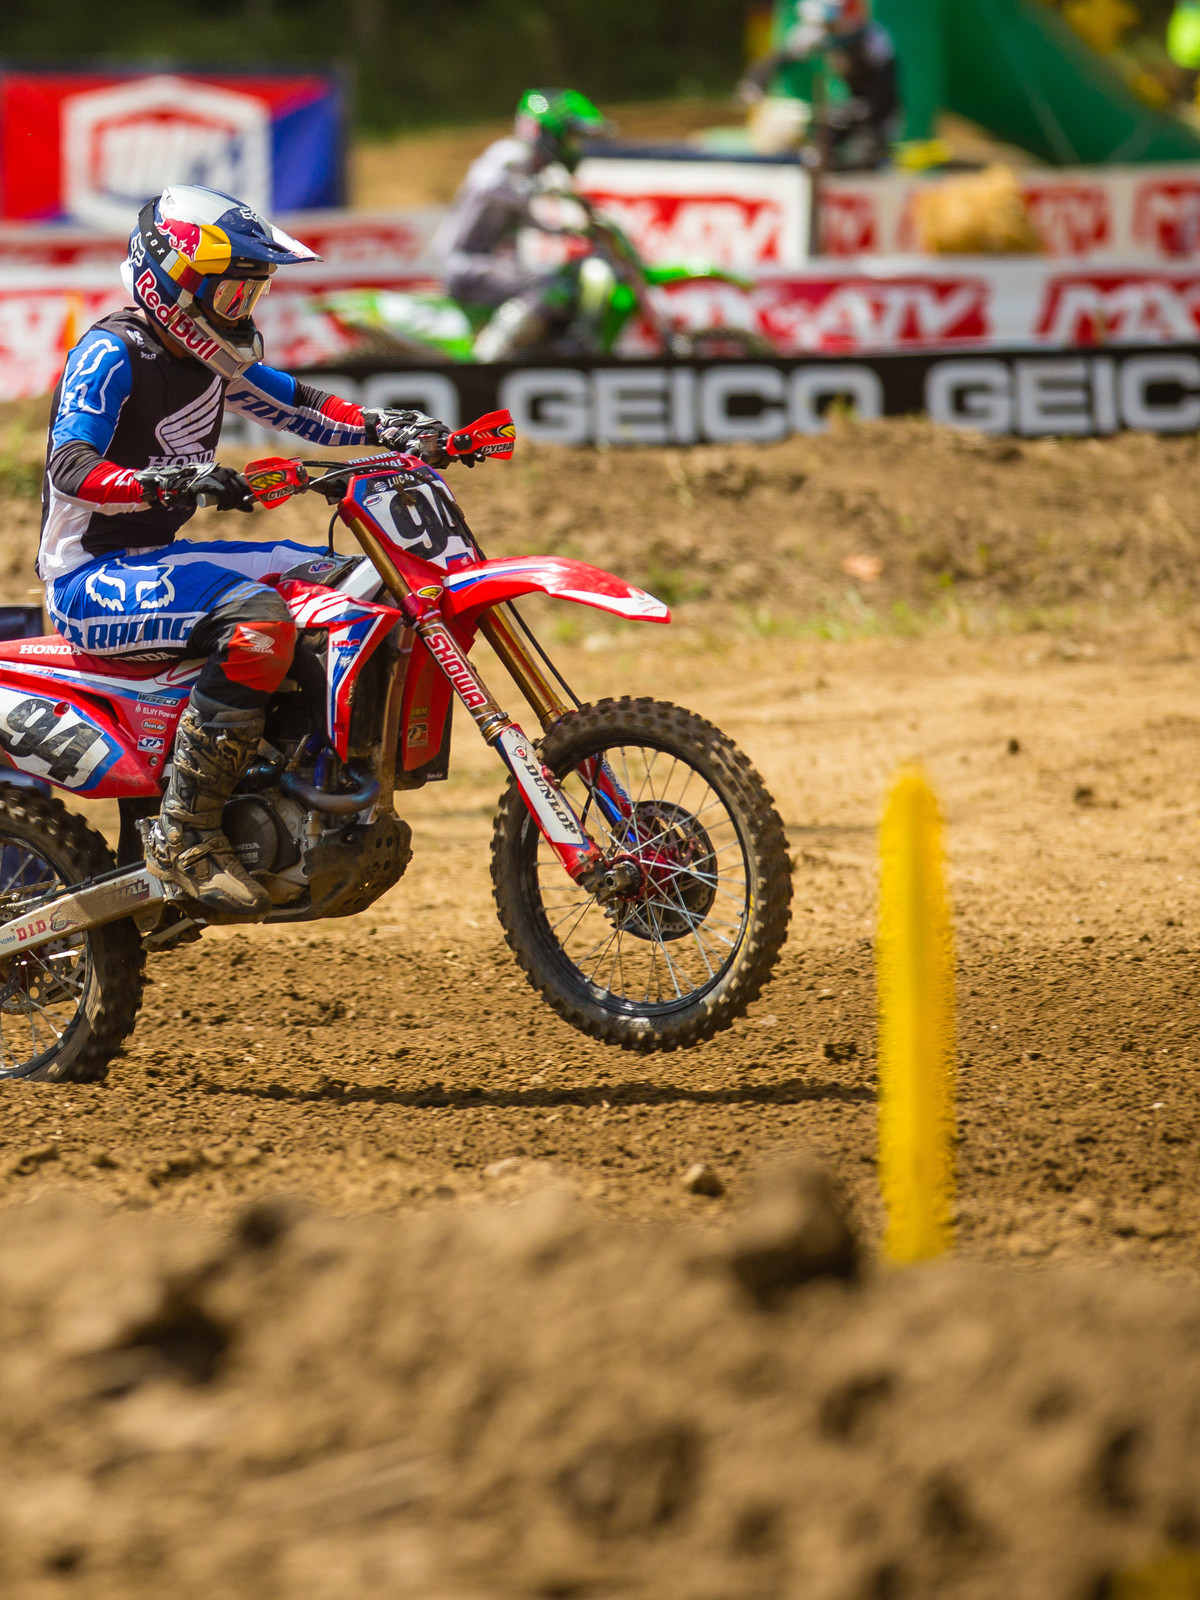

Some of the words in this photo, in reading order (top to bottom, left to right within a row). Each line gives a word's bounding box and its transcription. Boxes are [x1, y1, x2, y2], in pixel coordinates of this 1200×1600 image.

[135, 268, 180, 326] Red
[168, 310, 222, 362] Bull
[499, 364, 885, 446] GEICO
[19, 644, 84, 656] HONDA
[87, 615, 194, 650] RACING
[424, 632, 488, 711] SHOWA
[524, 764, 579, 836] DUNLOP
